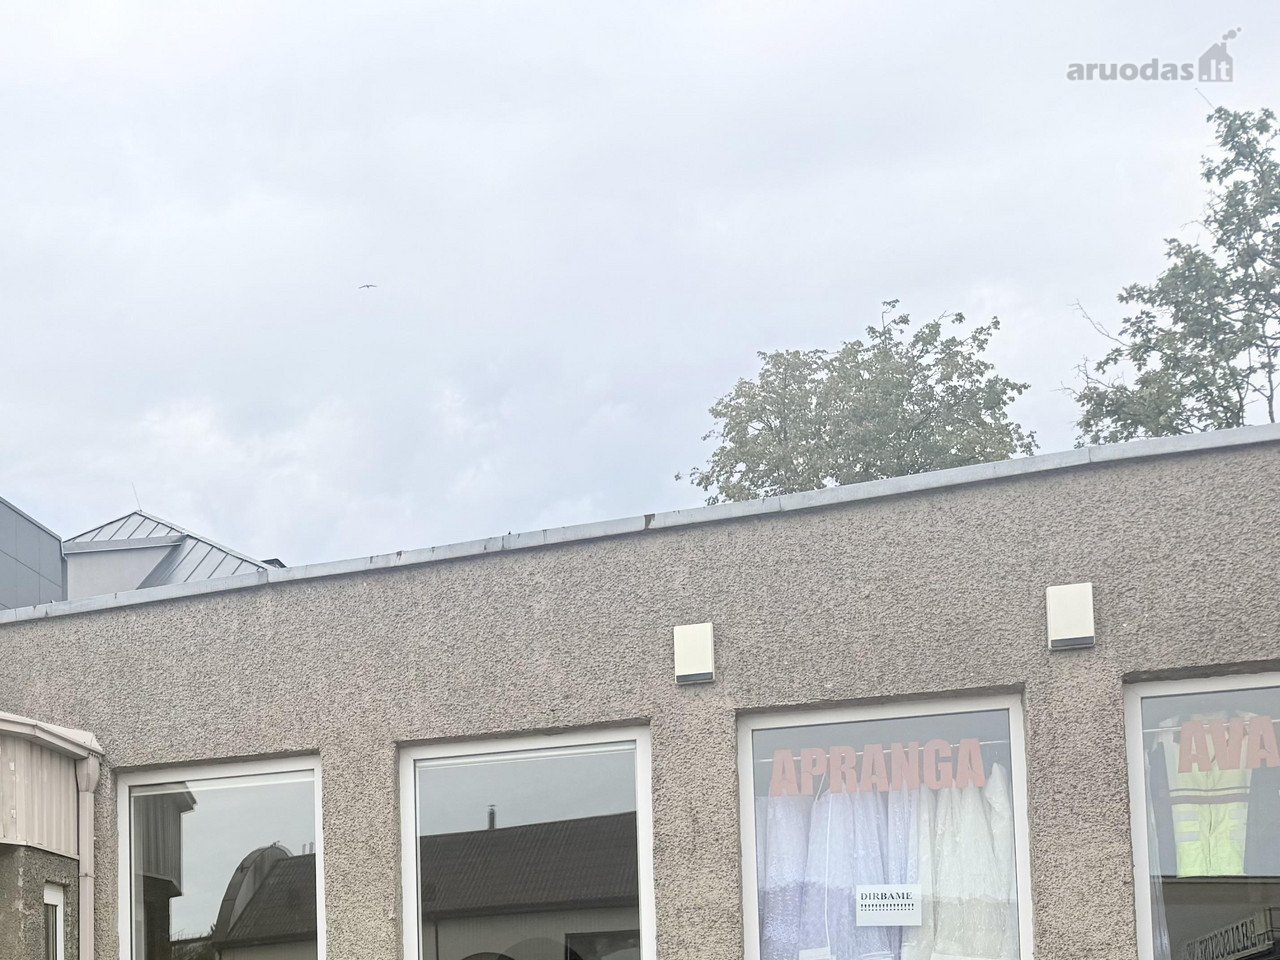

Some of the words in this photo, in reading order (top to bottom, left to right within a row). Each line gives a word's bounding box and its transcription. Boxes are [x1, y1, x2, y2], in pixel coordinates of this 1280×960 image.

[769, 737, 986, 797] APRANGA
[1178, 714, 1280, 774] AVA
[860, 892, 913, 901] DIRBAME
